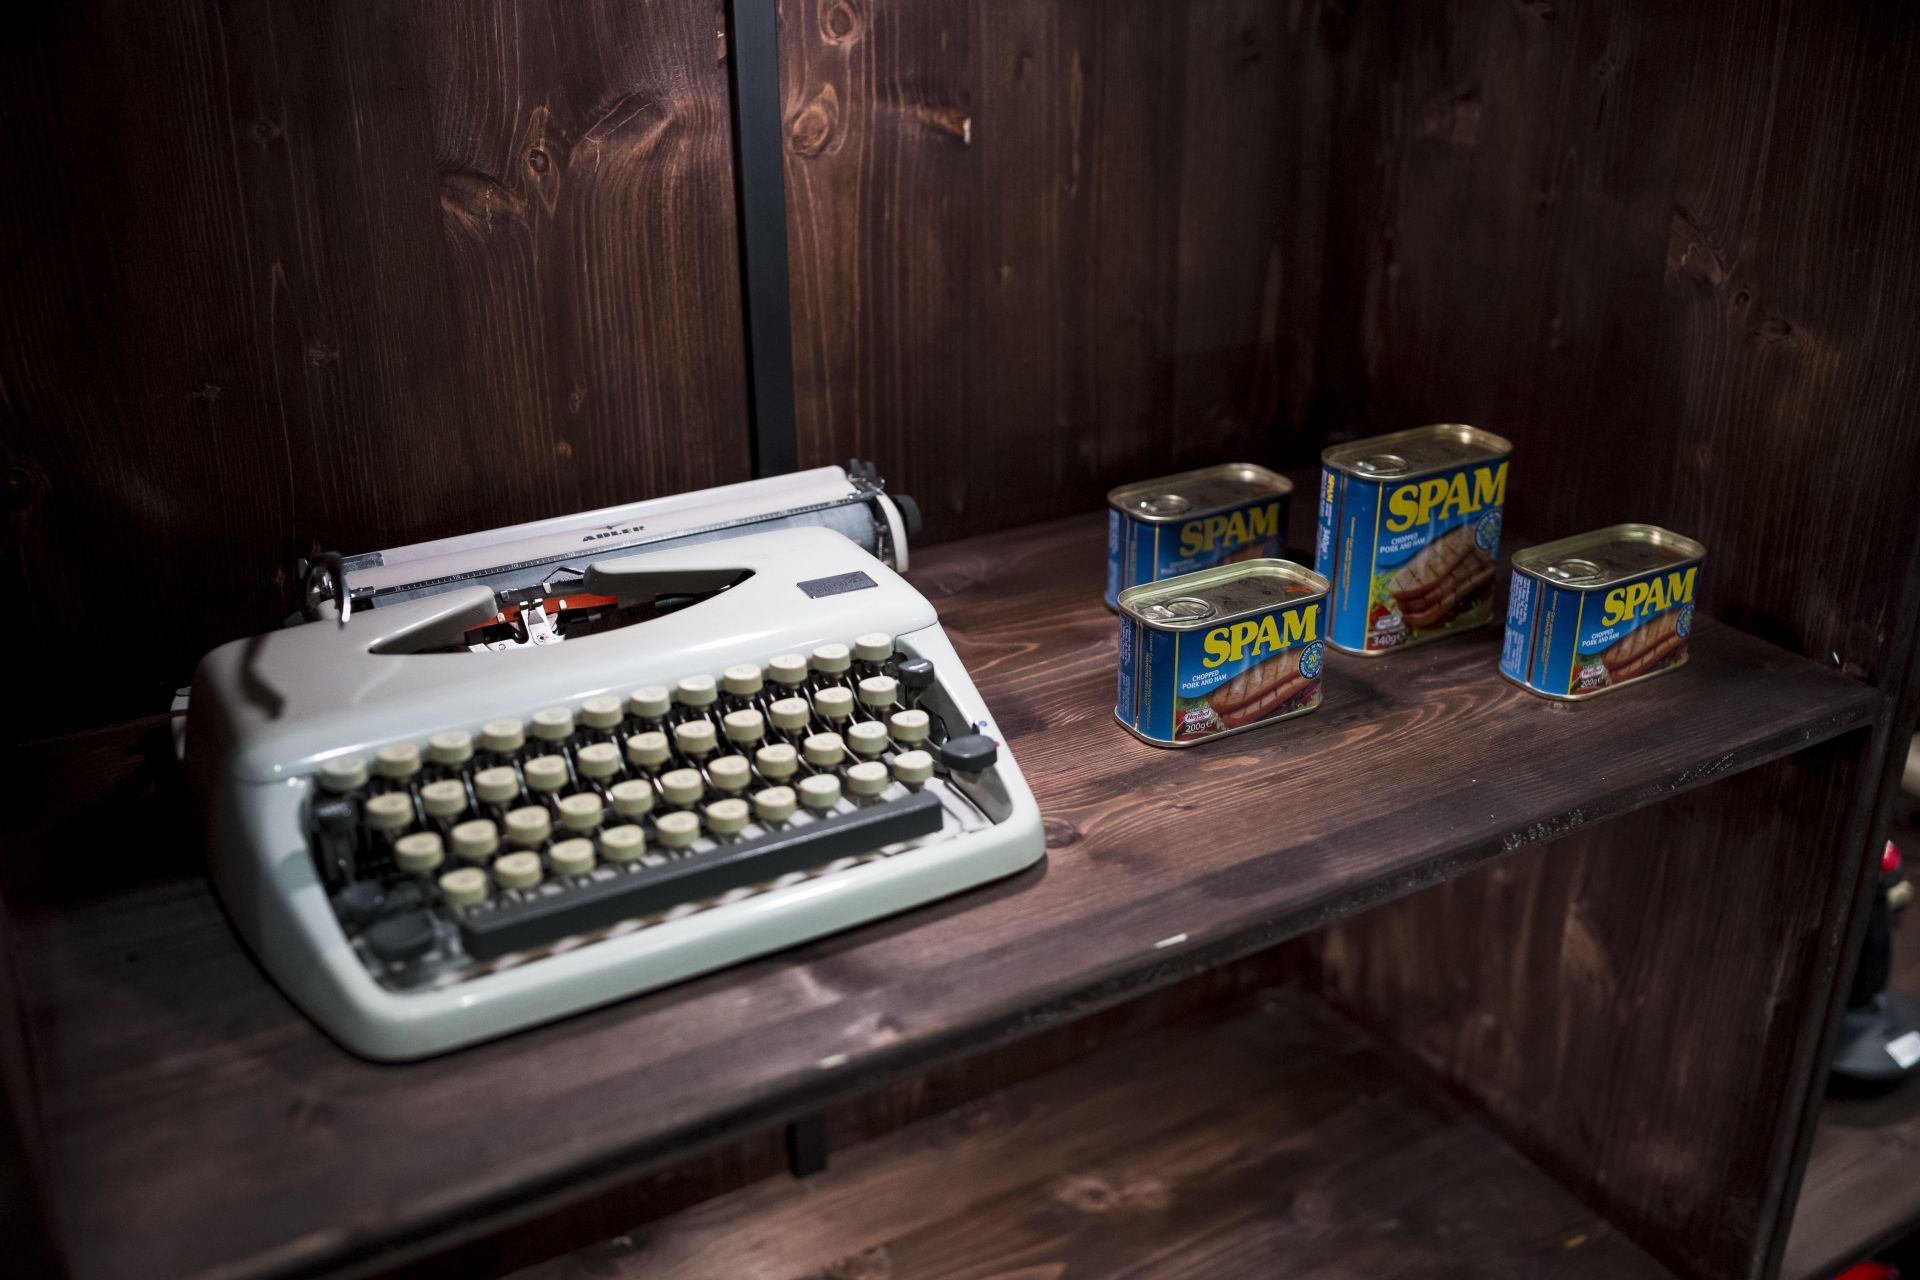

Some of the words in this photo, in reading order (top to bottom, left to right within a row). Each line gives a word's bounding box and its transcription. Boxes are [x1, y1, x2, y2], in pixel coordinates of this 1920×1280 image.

[1386, 460, 1509, 533] SPAM
[582, 524, 646, 543] ADLER
[1178, 502, 1281, 558] SPAM
[1601, 566, 1698, 628] SPAM
[1202, 603, 1320, 669] SPAM
[1598, 635, 1609, 643] AND
[1182, 681, 1200, 690] PORK
[1200, 677, 1214, 686] AND
[1214, 673, 1227, 682] HAM
[1191, 669, 1220, 682] CHOPPED
[1185, 722, 1206, 733] 200g
